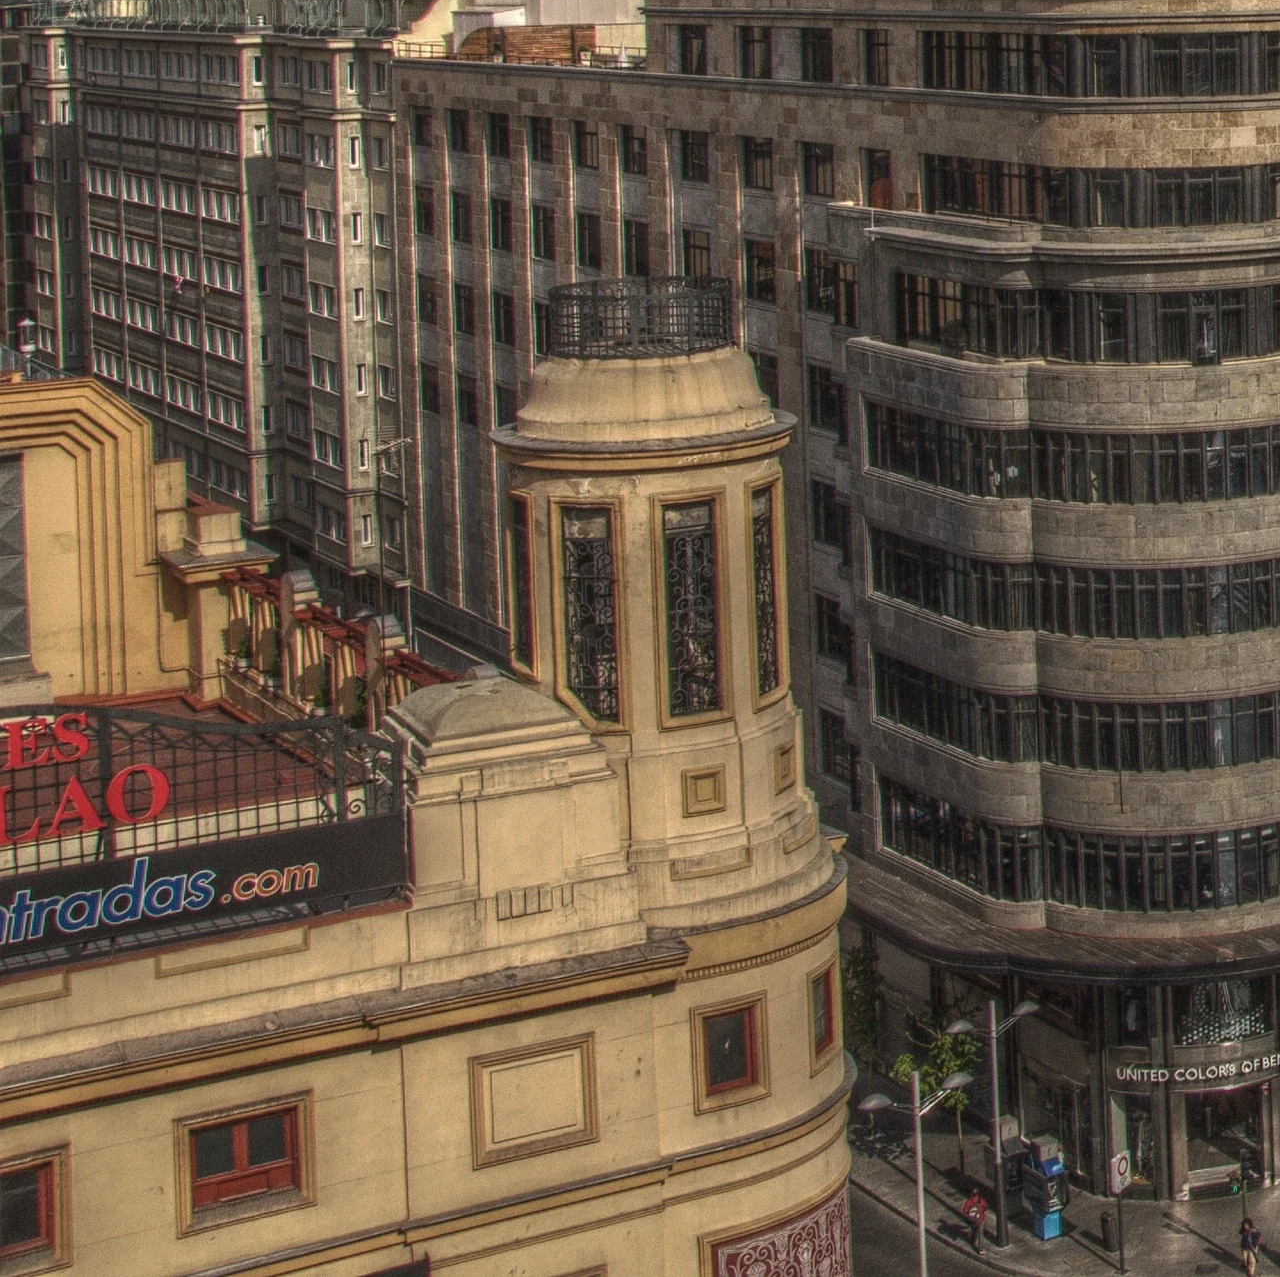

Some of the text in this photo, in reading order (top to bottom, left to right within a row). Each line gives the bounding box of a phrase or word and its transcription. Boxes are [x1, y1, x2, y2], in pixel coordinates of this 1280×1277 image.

[3, 711, 90, 771] ES
[1116, 1067, 1169, 1082] UNITED
[1241, 1059, 1260, 1074] OF
